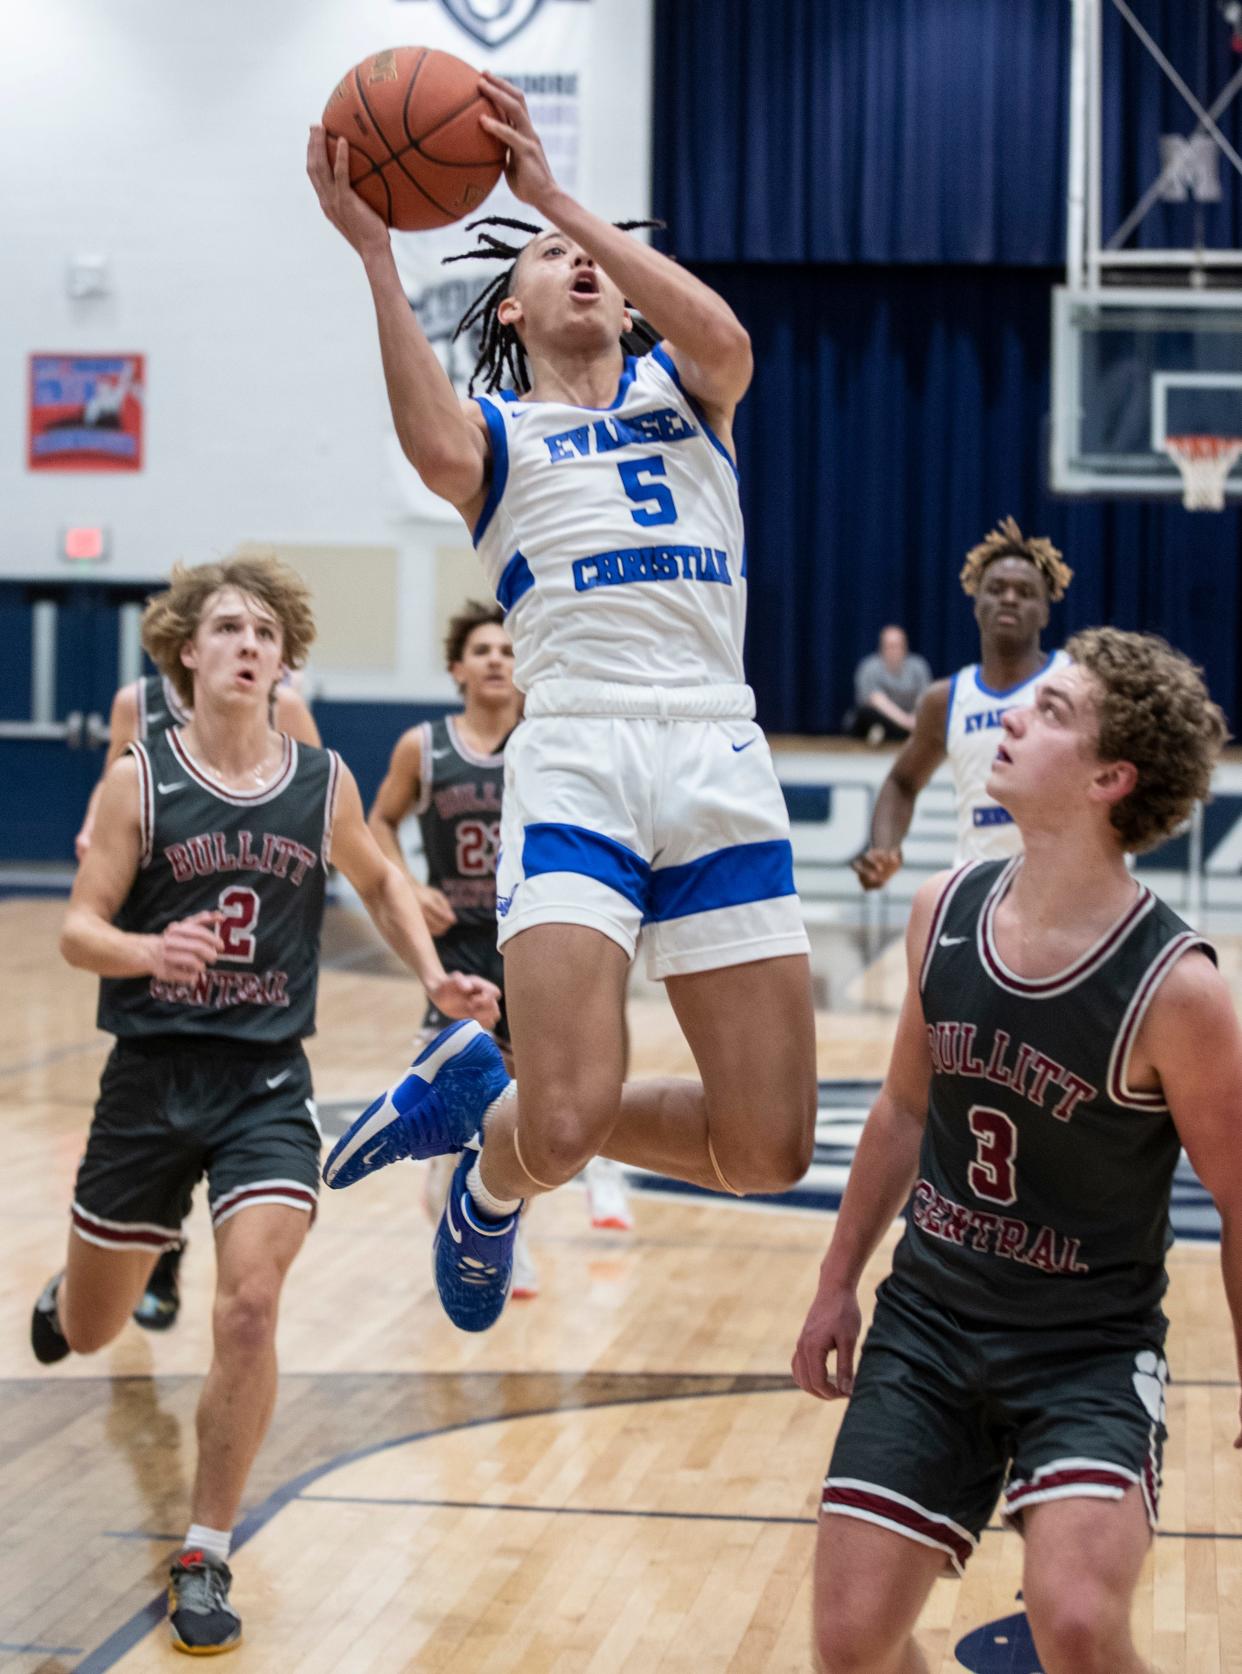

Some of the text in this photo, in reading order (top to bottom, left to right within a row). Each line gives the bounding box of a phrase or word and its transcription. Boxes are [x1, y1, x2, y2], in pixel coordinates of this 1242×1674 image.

[617, 455, 678, 527] 5
[572, 545, 733, 592] CHRISTIAN
[164, 830, 318, 886] BULLITT
[216, 885, 261, 963] 2
[968, 1105, 1018, 1207] 3
[913, 1178, 1089, 1275] CENTRAL
